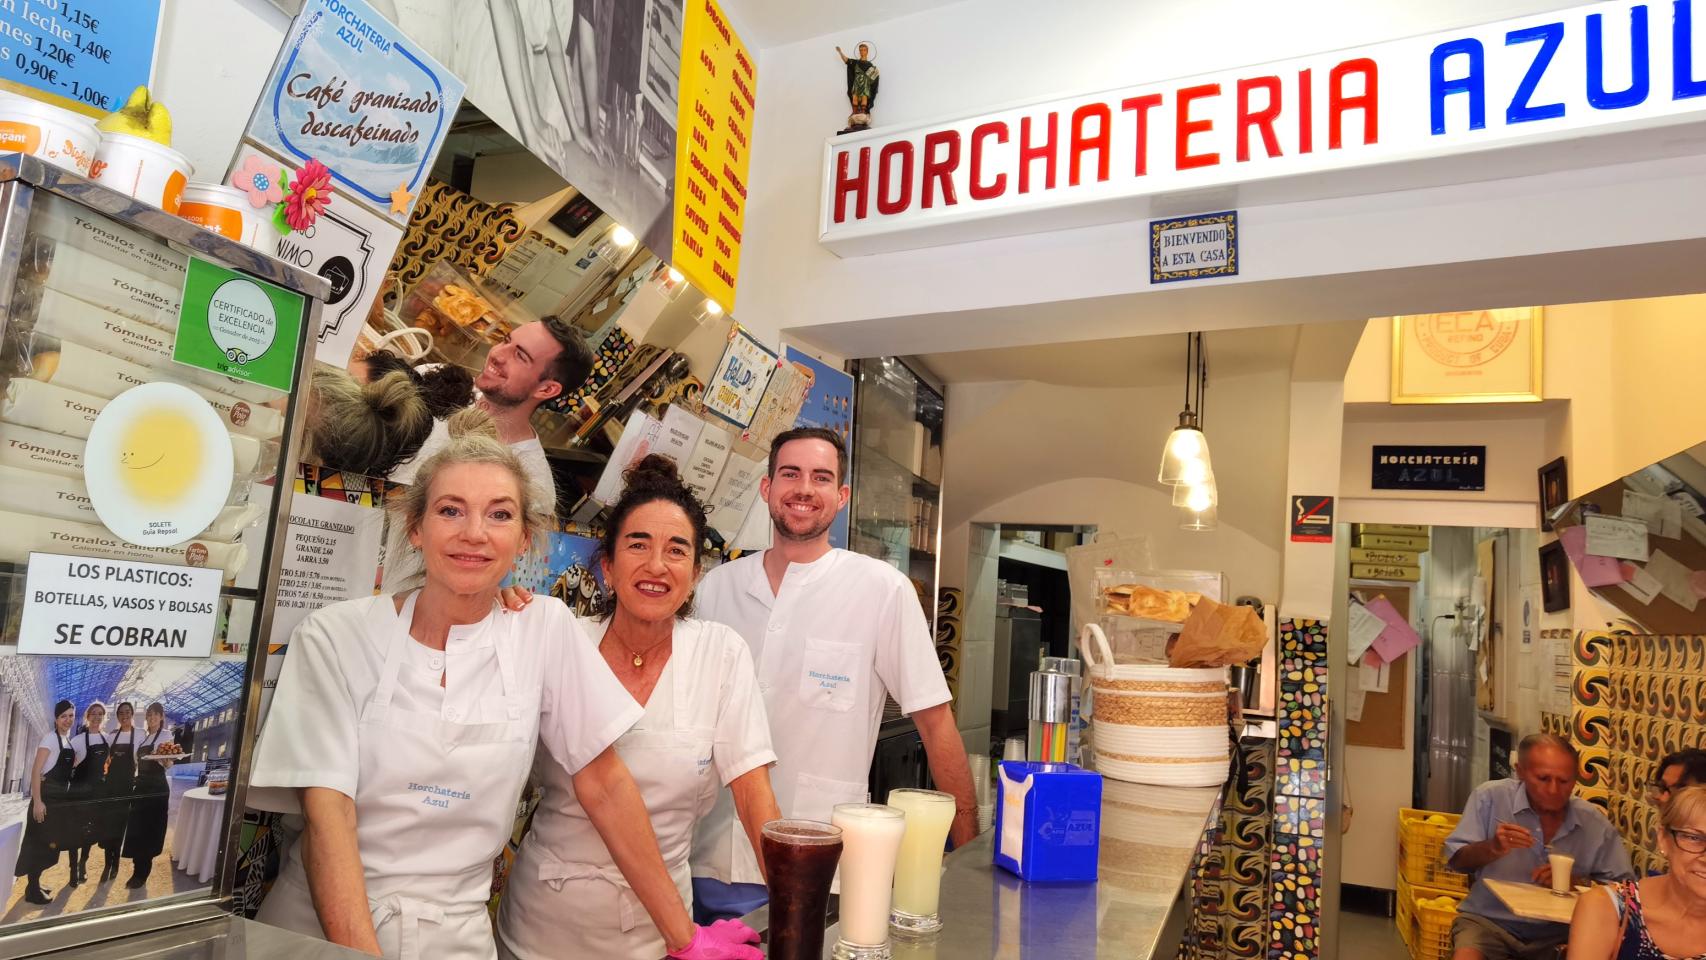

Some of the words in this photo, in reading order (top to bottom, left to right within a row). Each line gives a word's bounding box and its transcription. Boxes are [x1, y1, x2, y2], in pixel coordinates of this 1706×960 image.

[61, 2, 100, 34] 1,15€
[21, 1, 72, 42] leche
[74, 33, 112, 64] 1,40€
[336, 26, 363, 54] AZUL
[35, 37, 76, 69] 1,20€
[700, 49, 715, 78] AGUA
[16, 53, 58, 85] 0,90€
[72, 81, 110, 110] 1,00€
[286, 73, 347, 109] Café
[350, 92, 439, 114] granizado
[695, 99, 714, 131] LECHE
[833, 57, 1378, 223] HORCHATERIA
[1430, 0, 1706, 136] AZUL
[300, 112, 419, 147] descafeinado
[693, 126, 707, 152] NATA
[688, 177, 706, 205] FRESA
[74, 217, 136, 250] Tómalos
[682, 230, 703, 258] TARTAS
[716, 235, 731, 258] POLOS
[1164, 229, 1225, 247] BIENVENIDO
[93, 235, 128, 254] Calentar
[131, 252, 142, 260] en
[276, 238, 313, 267] NIMO
[1162, 256, 1169, 266] A
[1172, 252, 1196, 265] ESTA
[1200, 249, 1225, 262] CASA
[112, 278, 169, 306] Tómalos
[130, 295, 164, 310] Calentar
[166, 308, 176, 316] en
[213, 299, 265, 323] CERTIFICADO
[266, 318, 274, 326] de
[104, 321, 163, 347] Tómalos
[218, 313, 265, 335] EXCELENCIA
[122, 337, 158, 353] Calentar
[160, 350, 171, 358] en
[217, 362, 252, 377] tripadvisor
[9, 440, 79, 460] Tómalos
[30, 454, 72, 467] Calentar
[1398, 469, 1460, 482] AZUL
[157, 528, 178, 536] Repsol
[289, 515, 320, 527] OCOLATE
[320, 520, 355, 533] GRANIZADO
[50, 531, 116, 547] Tómalos
[72, 544, 111, 554] Calentar
[295, 544, 322, 554] GRANDE
[296, 554, 317, 563] JARRA
[68, 562, 101, 581] LOS
[105, 565, 193, 588] PLASTICOS:
[34, 591, 108, 610] BOTELLAS,
[112, 597, 156, 611] VASOS
[158, 599, 166, 611] Y
[168, 600, 213, 615] BOLSAS
[54, 623, 85, 645] SE
[90, 625, 187, 649] COBRAN
[421, 796, 450, 809] Azul
